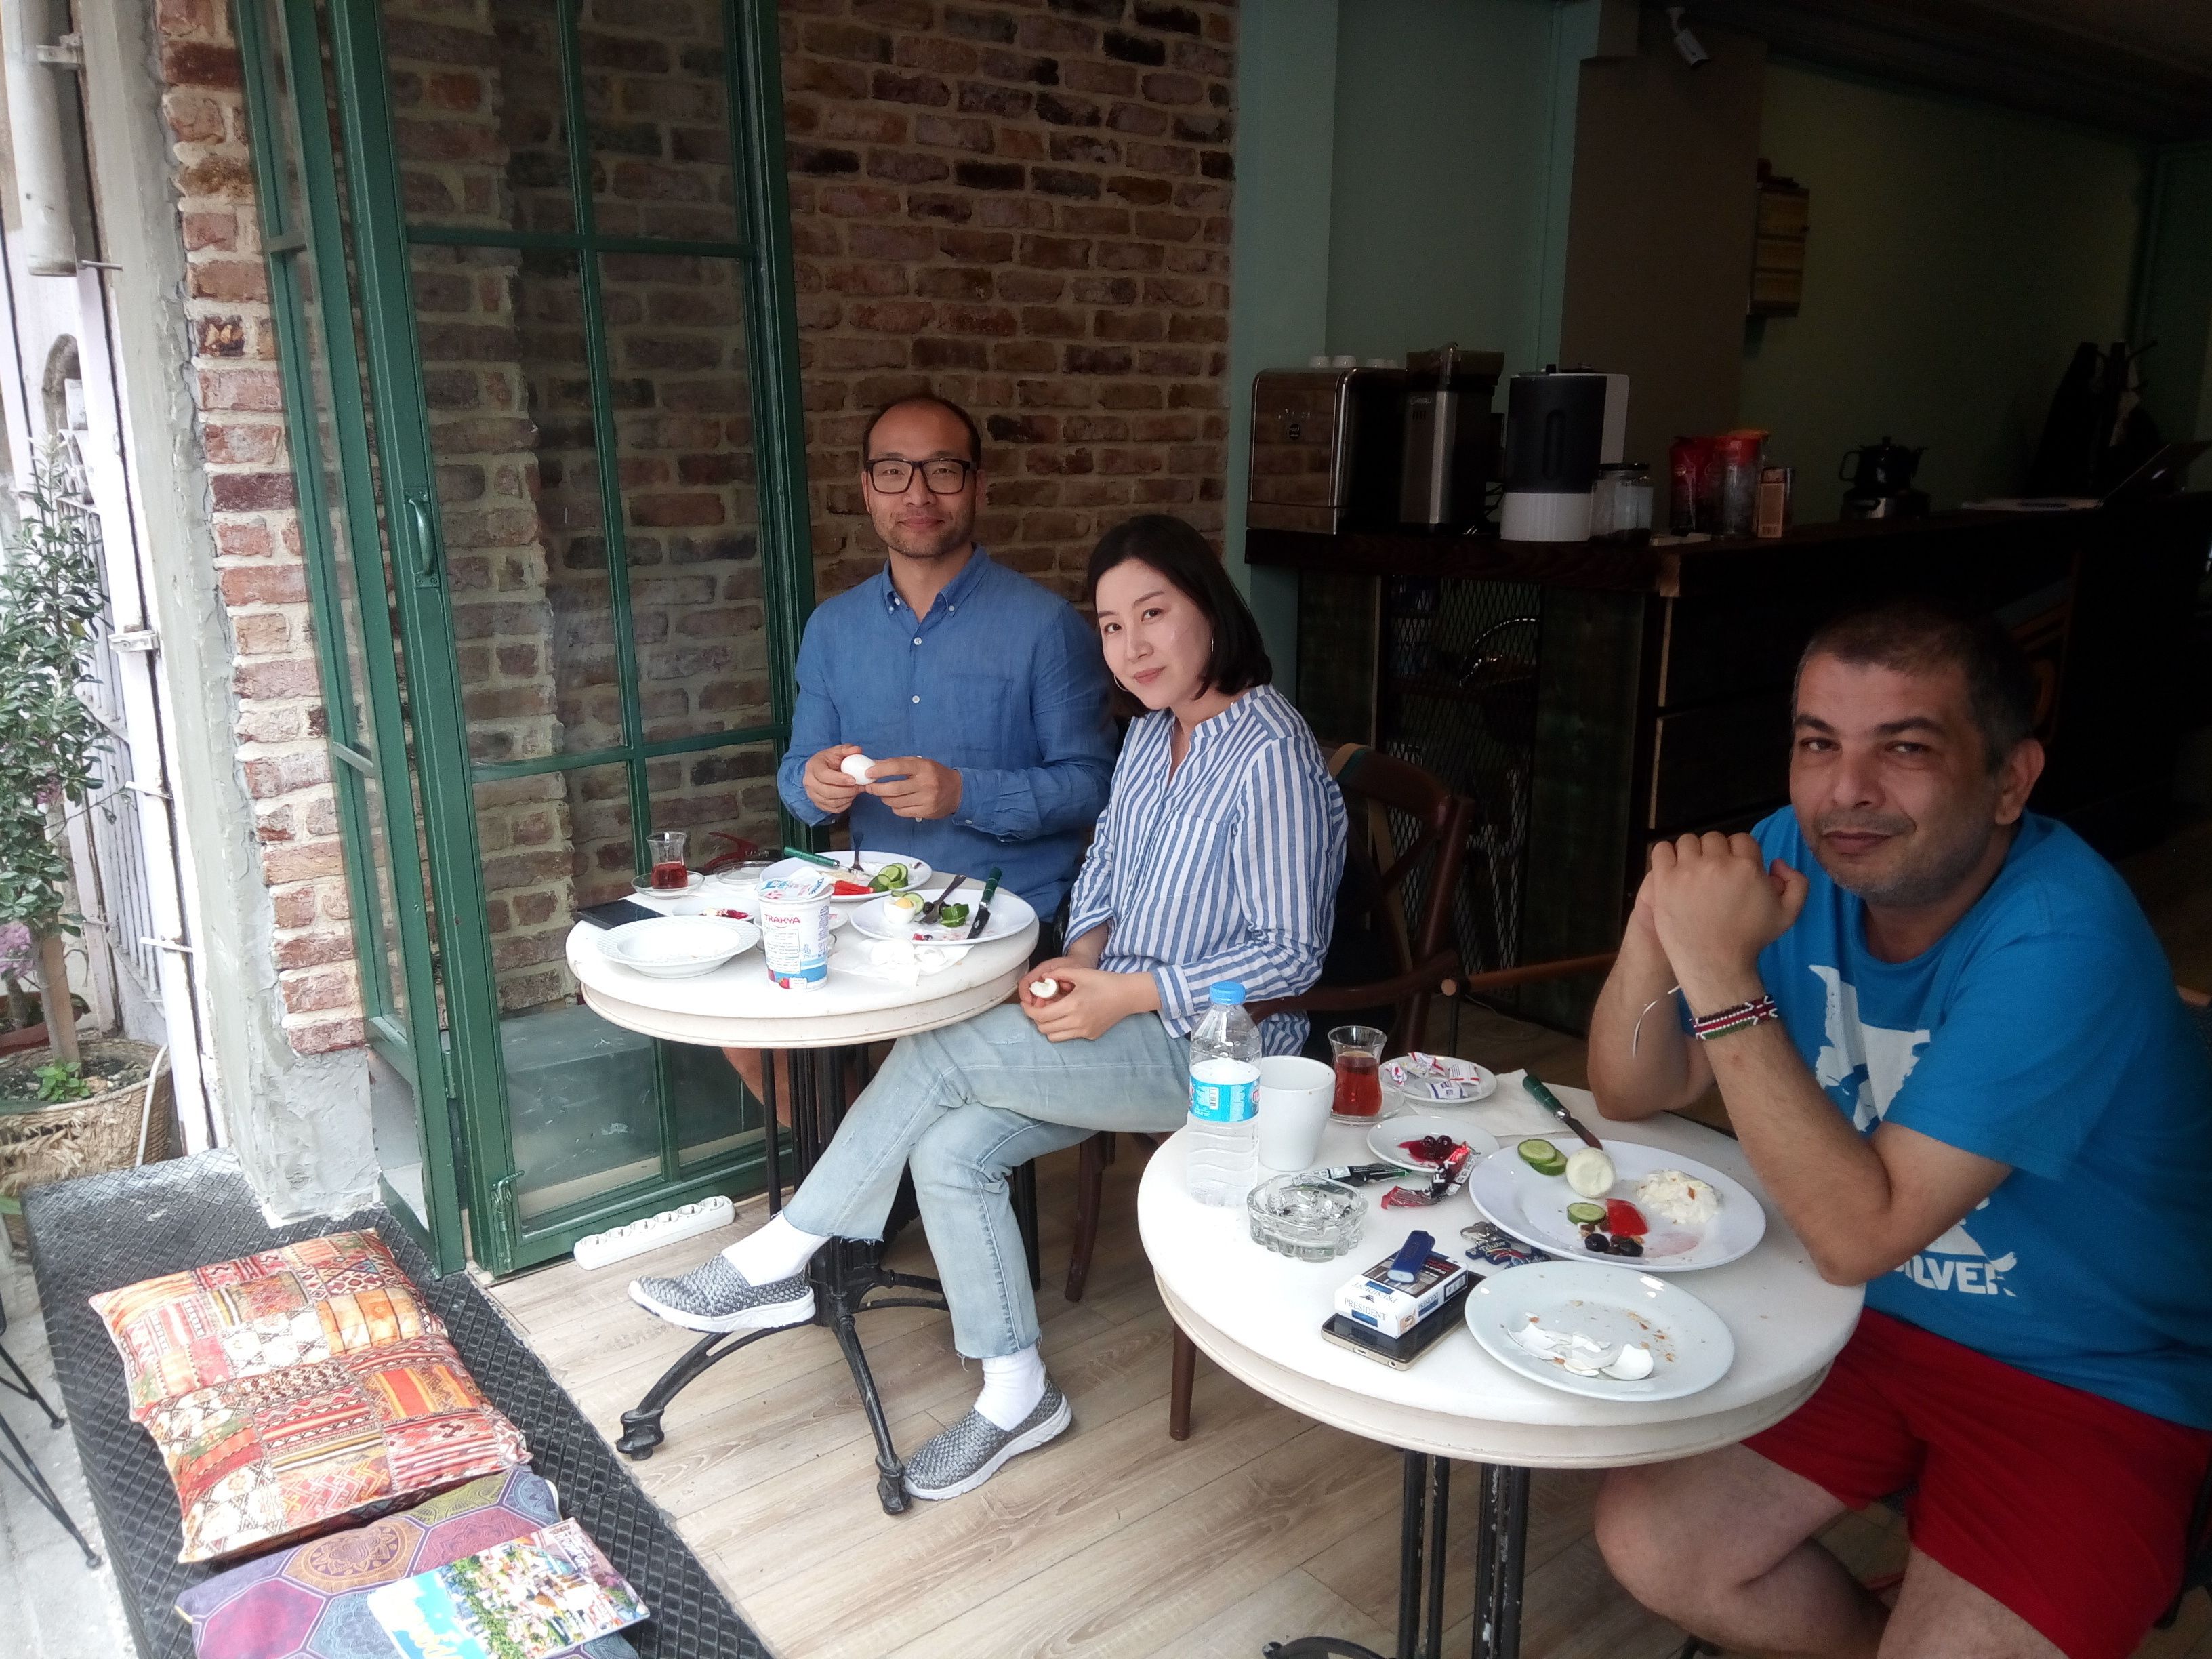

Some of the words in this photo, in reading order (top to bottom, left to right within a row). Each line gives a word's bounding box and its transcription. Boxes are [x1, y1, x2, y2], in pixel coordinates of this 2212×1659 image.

[764, 913, 800, 924] TRAKYA
[1479, 1241, 1506, 1252] Tchibo
[1344, 1297, 1387, 1321] PRESIDENT
